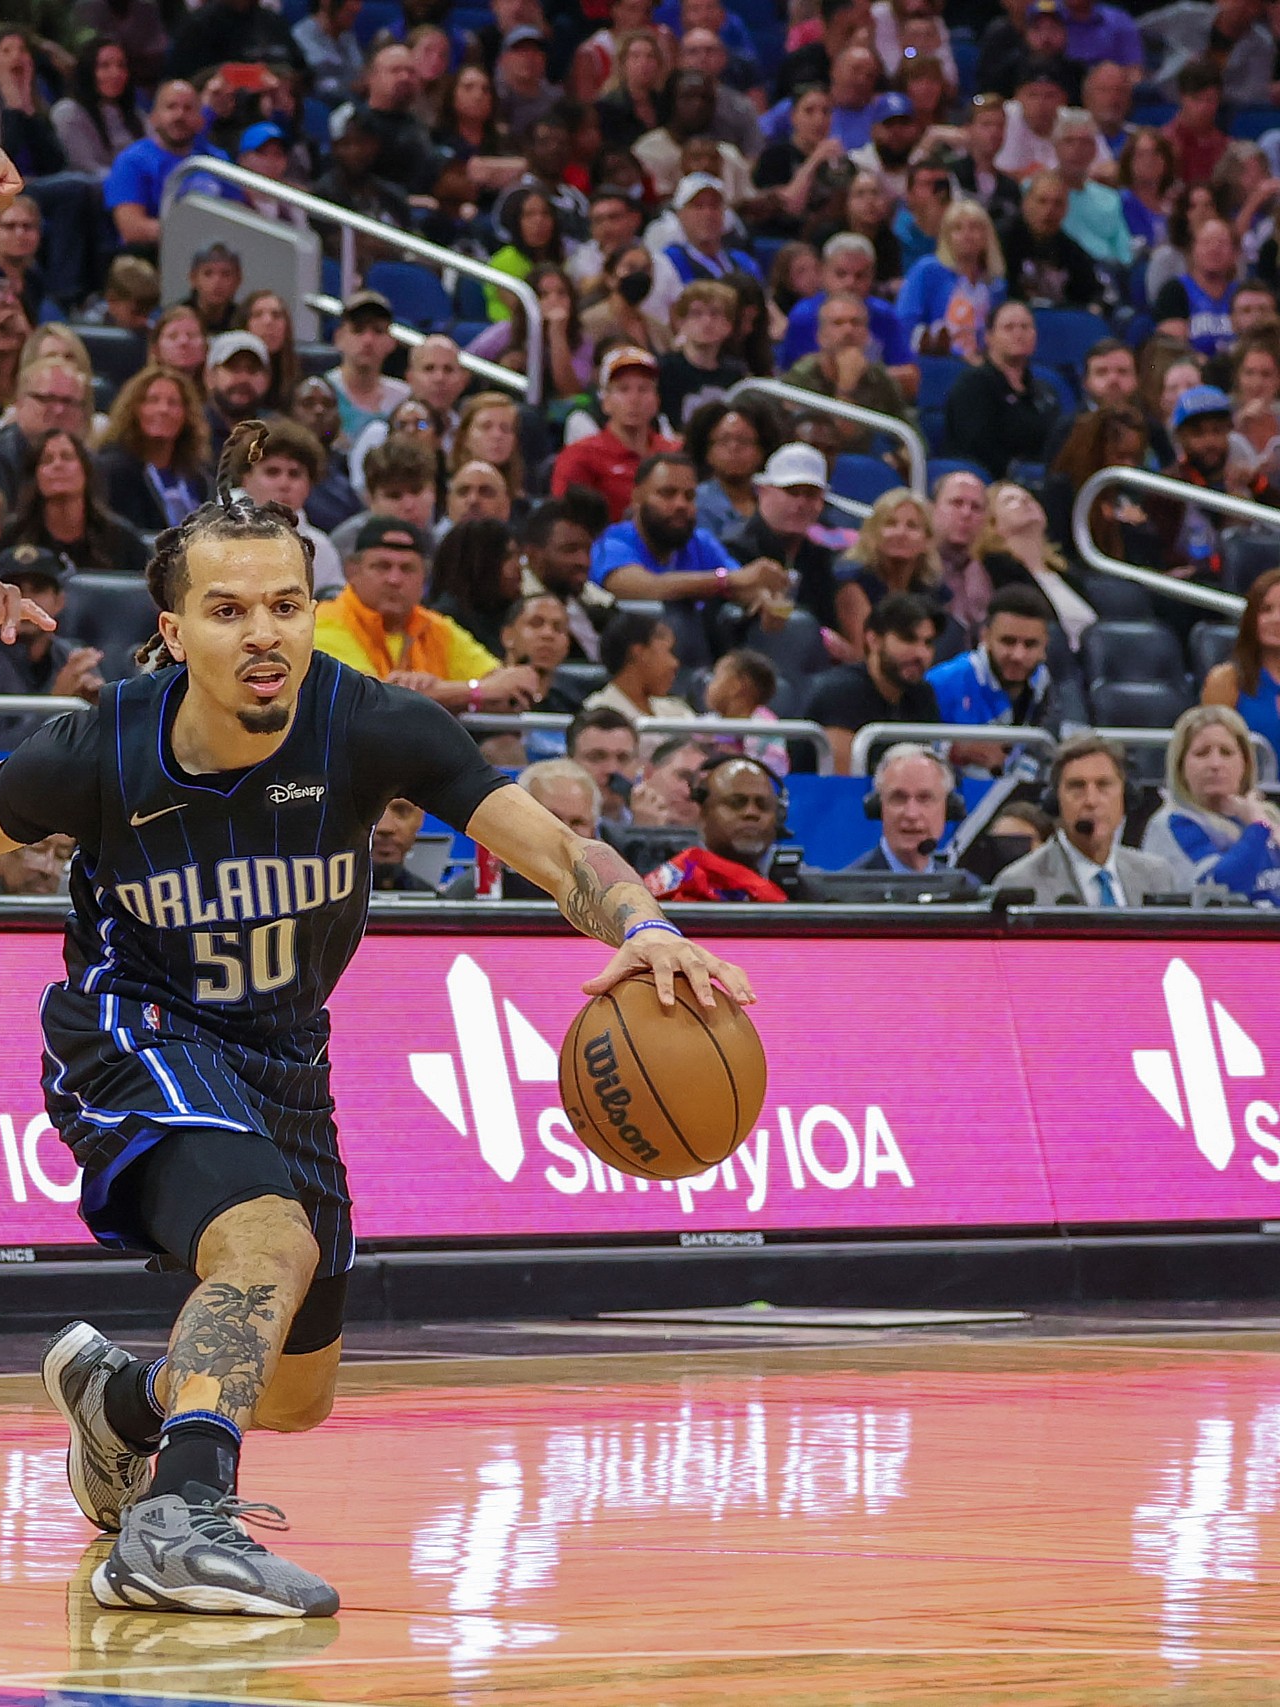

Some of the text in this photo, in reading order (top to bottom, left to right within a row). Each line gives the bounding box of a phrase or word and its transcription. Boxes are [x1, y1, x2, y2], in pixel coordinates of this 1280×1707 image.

[116, 851, 357, 929] ORLANDO
[190, 917, 298, 1004] 50
[583, 1027, 661, 1164] Wilson
[777, 1104, 914, 1190] IOA
